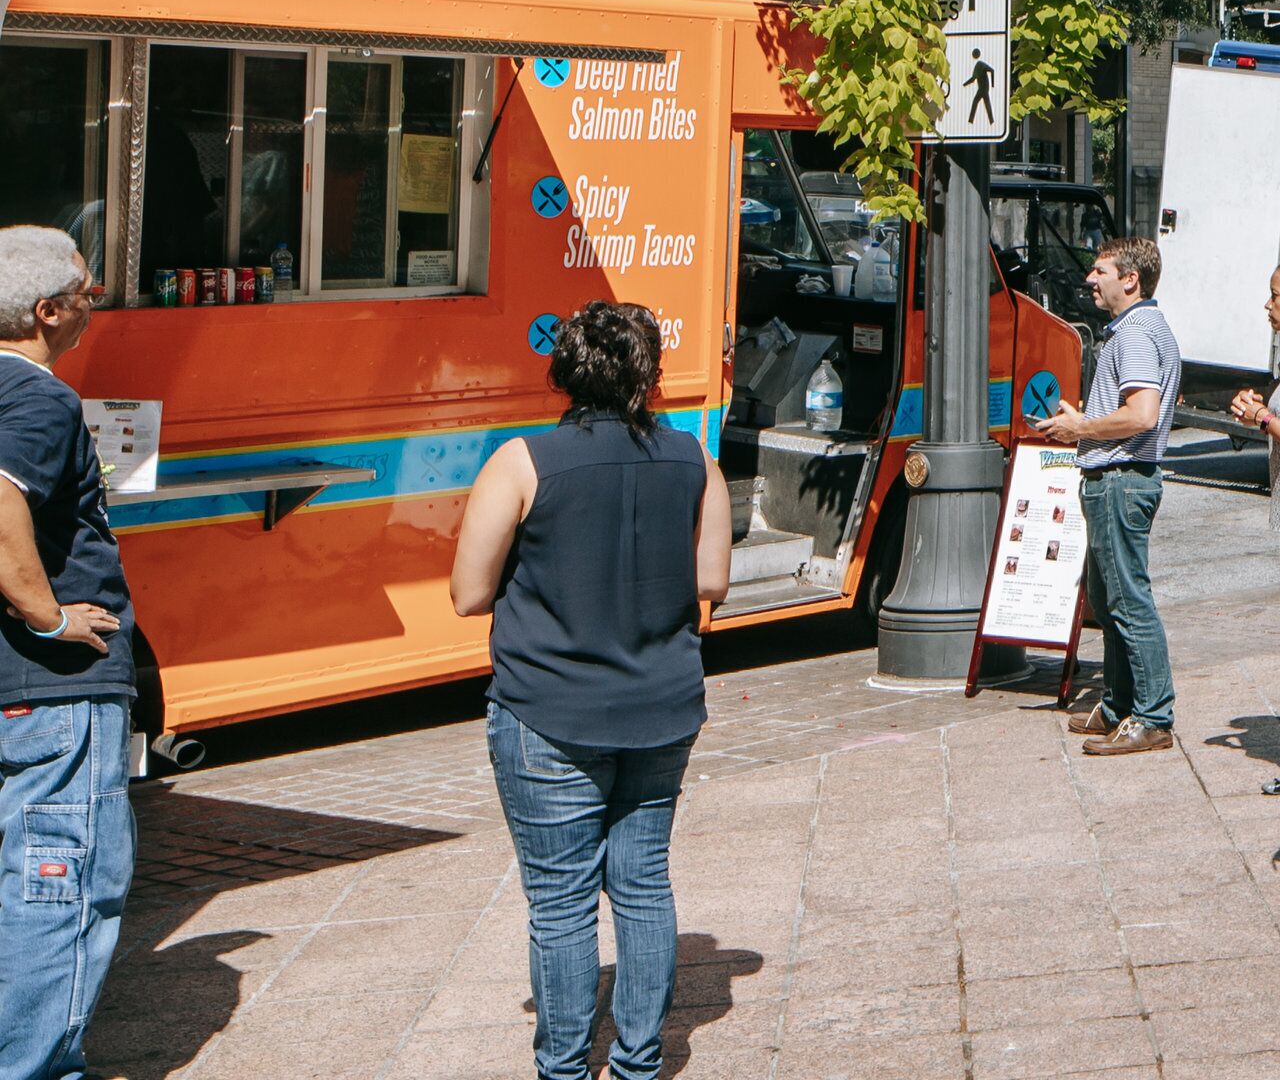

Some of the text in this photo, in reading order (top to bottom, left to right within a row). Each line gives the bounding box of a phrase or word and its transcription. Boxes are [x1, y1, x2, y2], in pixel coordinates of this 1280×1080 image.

[568, 96, 697, 140] Salmon Bites
[571, 175, 630, 224] Spicy
[564, 224, 696, 274] Shrimp Tacos
